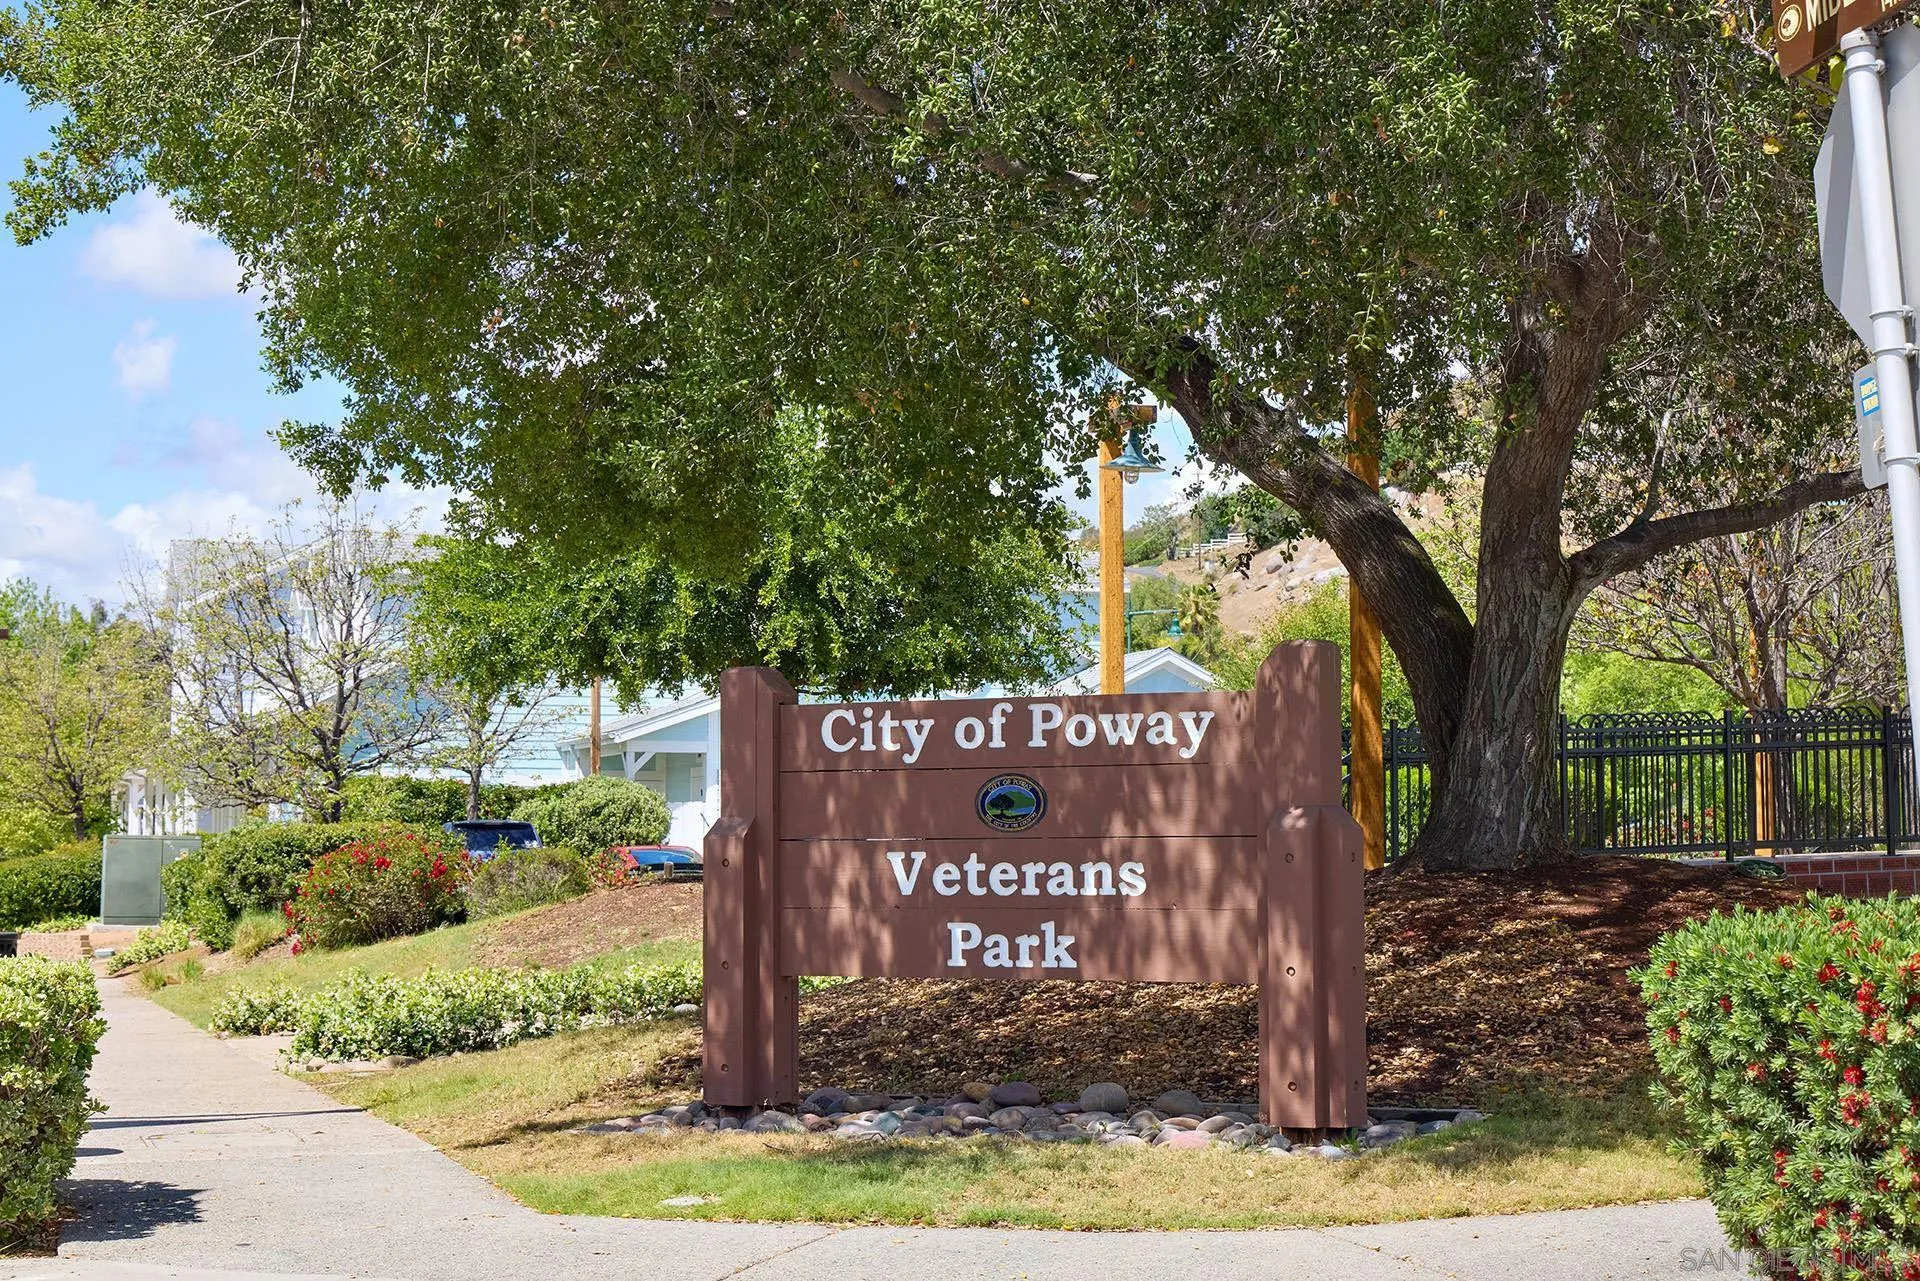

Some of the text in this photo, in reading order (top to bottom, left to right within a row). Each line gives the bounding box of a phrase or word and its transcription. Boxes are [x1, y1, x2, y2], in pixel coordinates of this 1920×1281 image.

[821, 702, 1215, 764] City of Poway
[988, 780, 1001, 792] CITY
[886, 851, 1147, 897] Veterans
[946, 920, 1078, 969] Park
